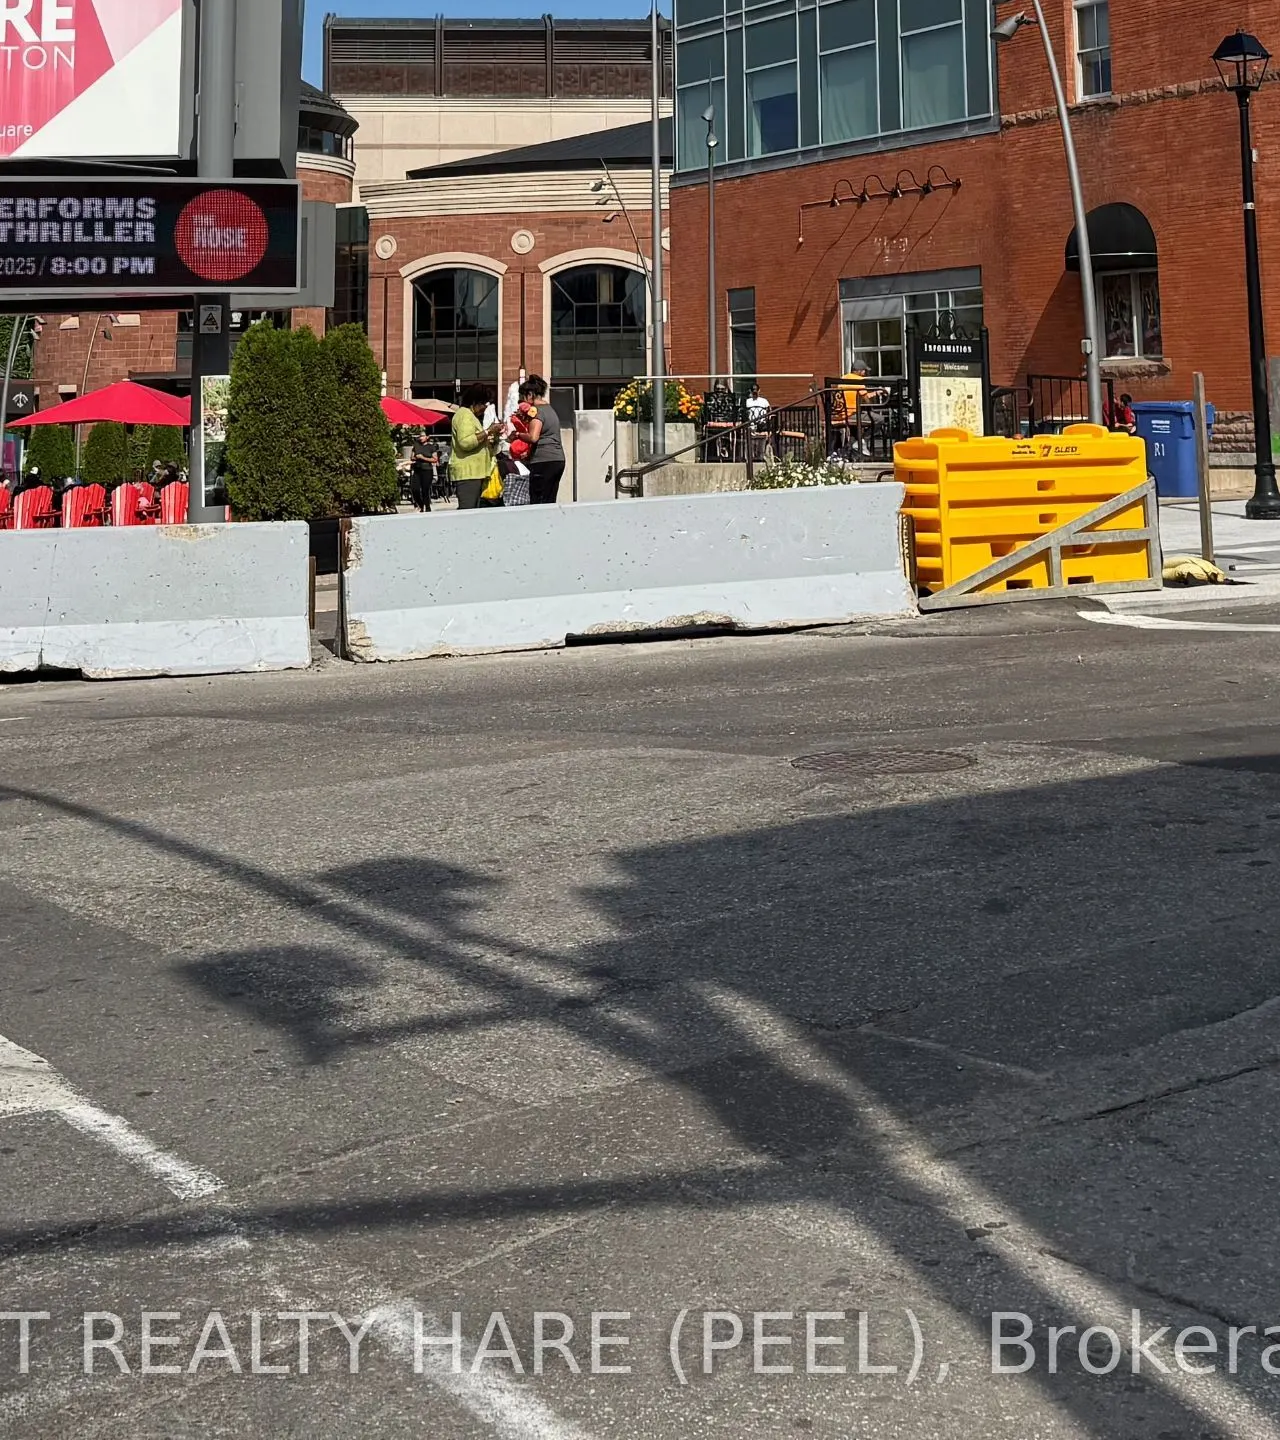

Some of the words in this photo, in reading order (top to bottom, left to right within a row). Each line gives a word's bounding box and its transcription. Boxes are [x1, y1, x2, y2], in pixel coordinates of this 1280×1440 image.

[50, 257, 107, 274] 8:00
[112, 257, 156, 274] PM
[1154, 442, 1165, 457] R1
